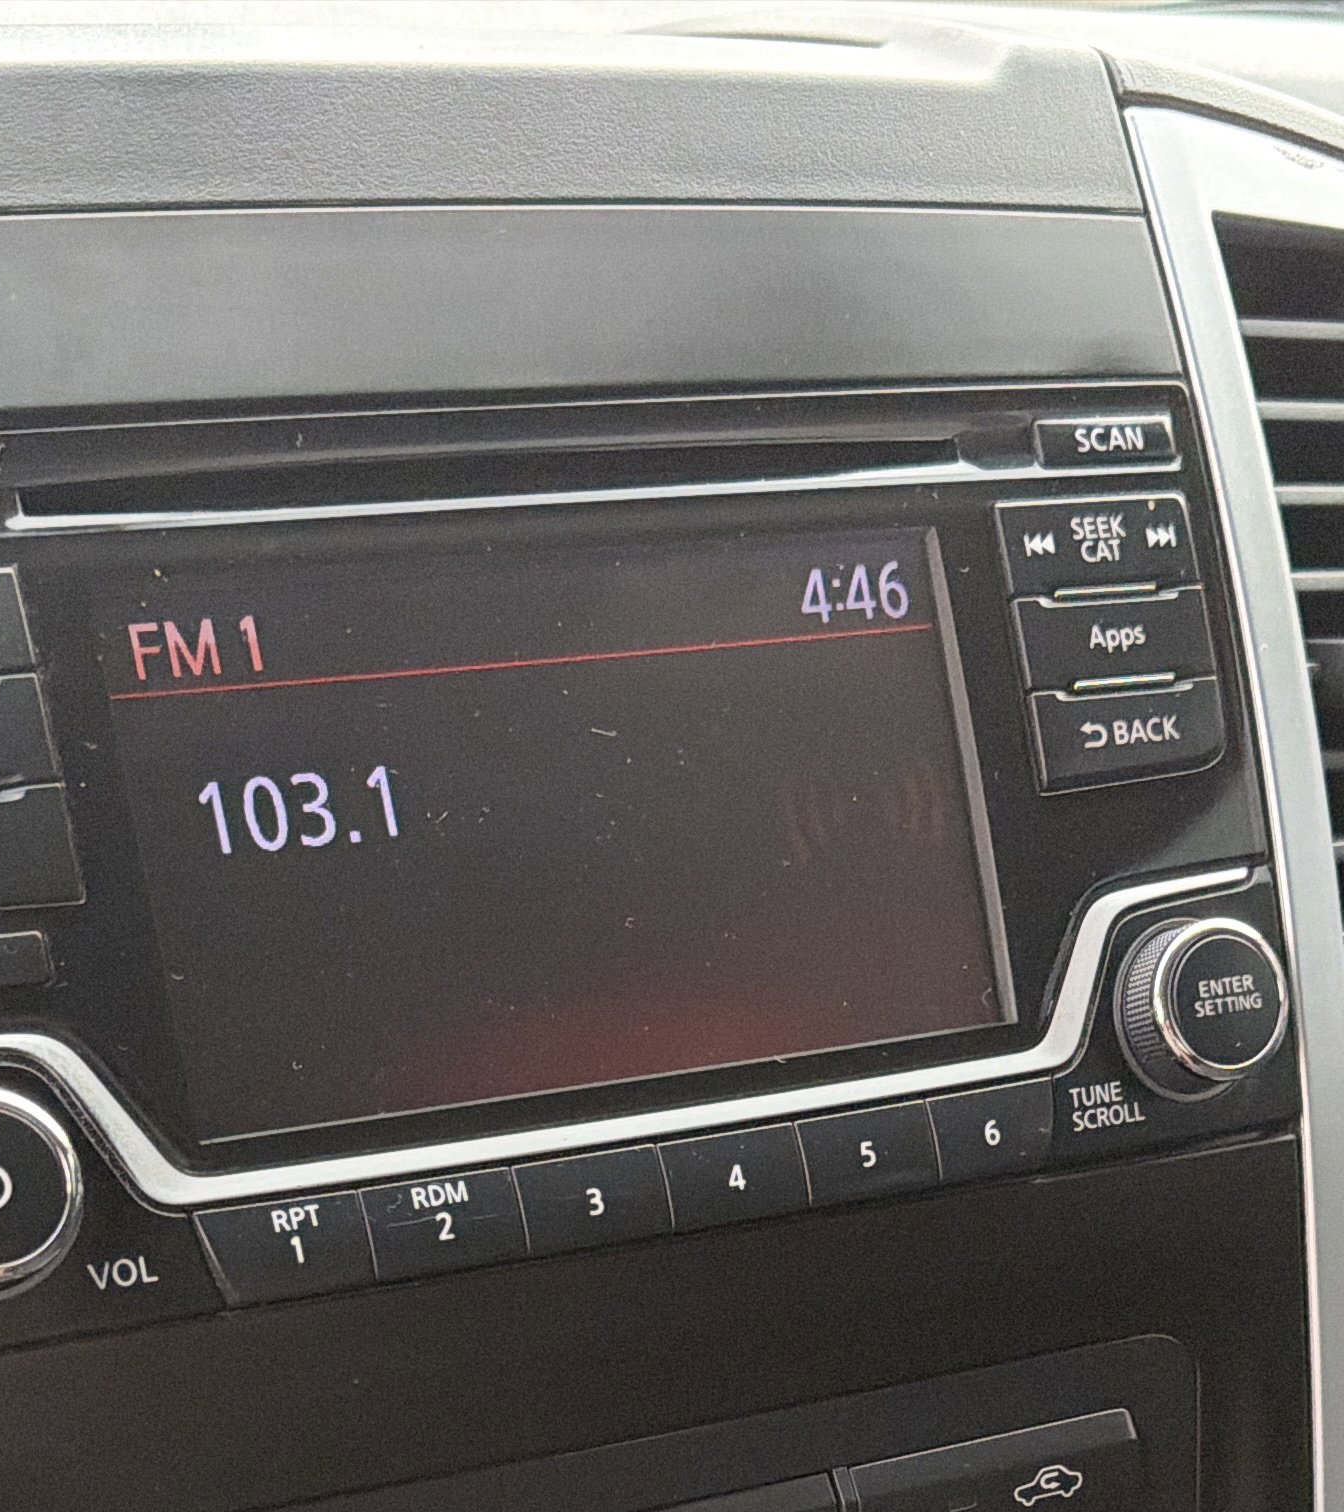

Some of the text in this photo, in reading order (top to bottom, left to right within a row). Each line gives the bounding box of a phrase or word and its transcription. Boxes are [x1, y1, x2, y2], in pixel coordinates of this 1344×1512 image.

[1074, 426, 1145, 453] SCAN
[1070, 514, 1127, 541] SEEK
[1080, 538, 1123, 563] CAT
[800, 560, 909, 624] 4:46
[1089, 624, 1146, 653] Apps
[1112, 715, 1181, 746] BACK
[198, 765, 399, 855] 103.1
[1198, 974, 1255, 998] ENTER
[1194, 992, 1263, 1018] SETTING
[1069, 1081, 1124, 1106] TUNE
[1072, 1100, 1146, 1132] SCROLL
[984, 1119, 1001, 1146] 6
[860, 1140, 877, 1168] 5
[728, 1163, 747, 1191] 4
[410, 1181, 469, 1210] RDM
[585, 1187, 605, 1217] 3
[271, 1203, 320, 1233] RPT
[434, 1211, 455, 1241] 2
[290, 1235, 305, 1264] 1
[86, 1255, 160, 1290] VOL
